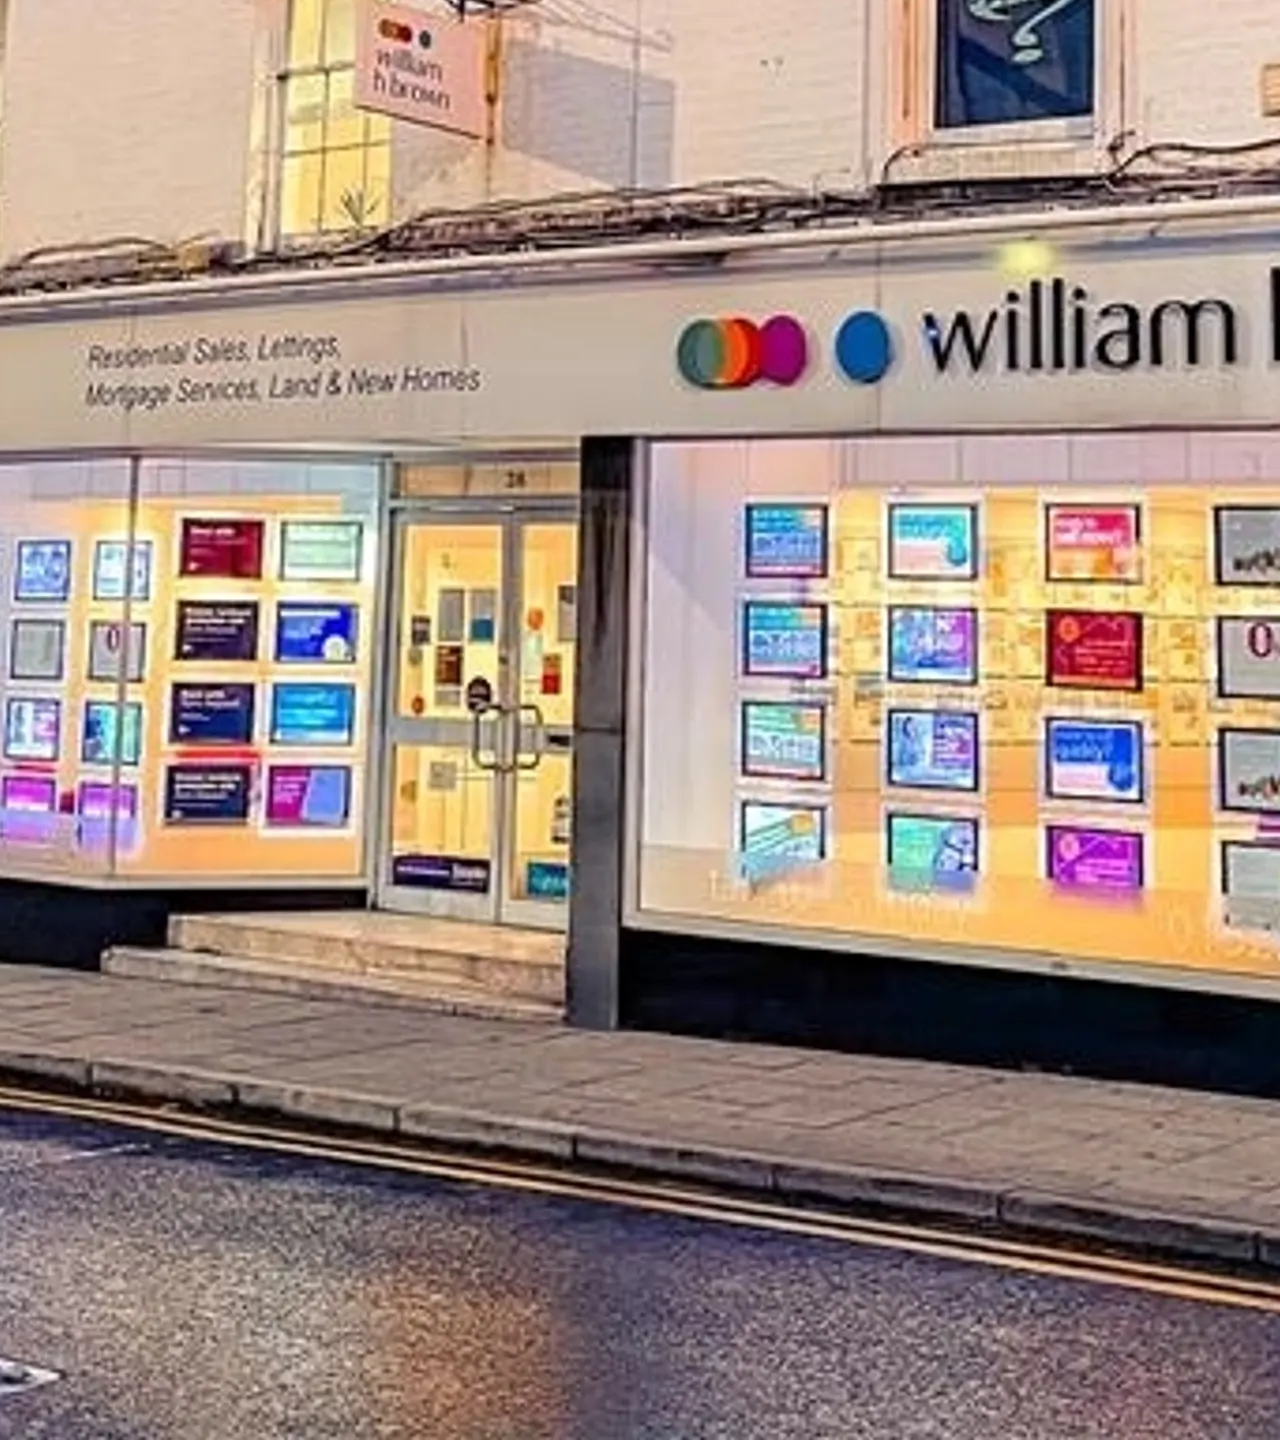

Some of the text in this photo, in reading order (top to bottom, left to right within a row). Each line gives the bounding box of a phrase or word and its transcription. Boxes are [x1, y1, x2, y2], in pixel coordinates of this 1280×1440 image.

[922, 277, 1237, 373] william
[86, 332, 343, 370] Residential Sales, Lettings,
[85, 365, 482, 412] Mortgage Services, Land & New Homes
